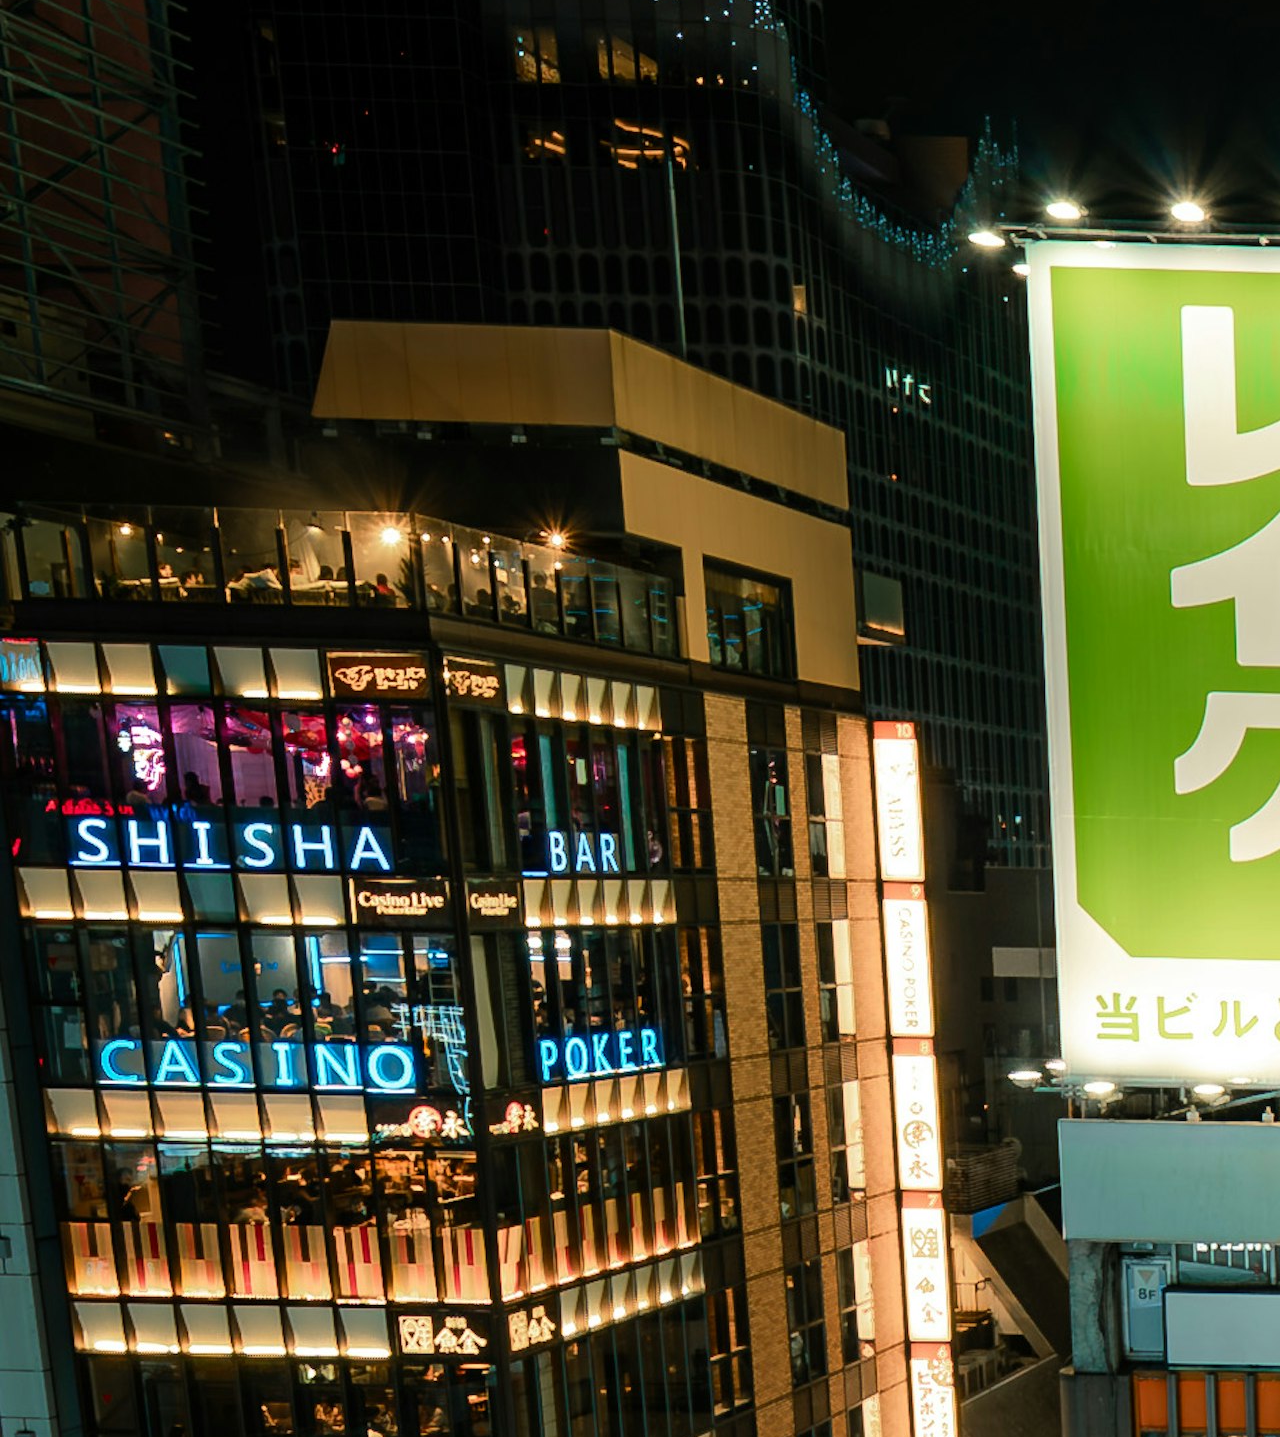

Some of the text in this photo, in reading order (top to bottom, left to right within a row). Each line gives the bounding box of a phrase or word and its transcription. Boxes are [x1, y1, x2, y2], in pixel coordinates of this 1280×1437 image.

[894, 723, 913, 738] 10
[77, 818, 391, 871] SHISHA
[549, 831, 620, 875] BAR
[358, 891, 445, 909] Casino Live
[903, 977, 921, 1030] POKER
[100, 1039, 416, 1090] CASINO
[540, 1028, 664, 1082] POKER
